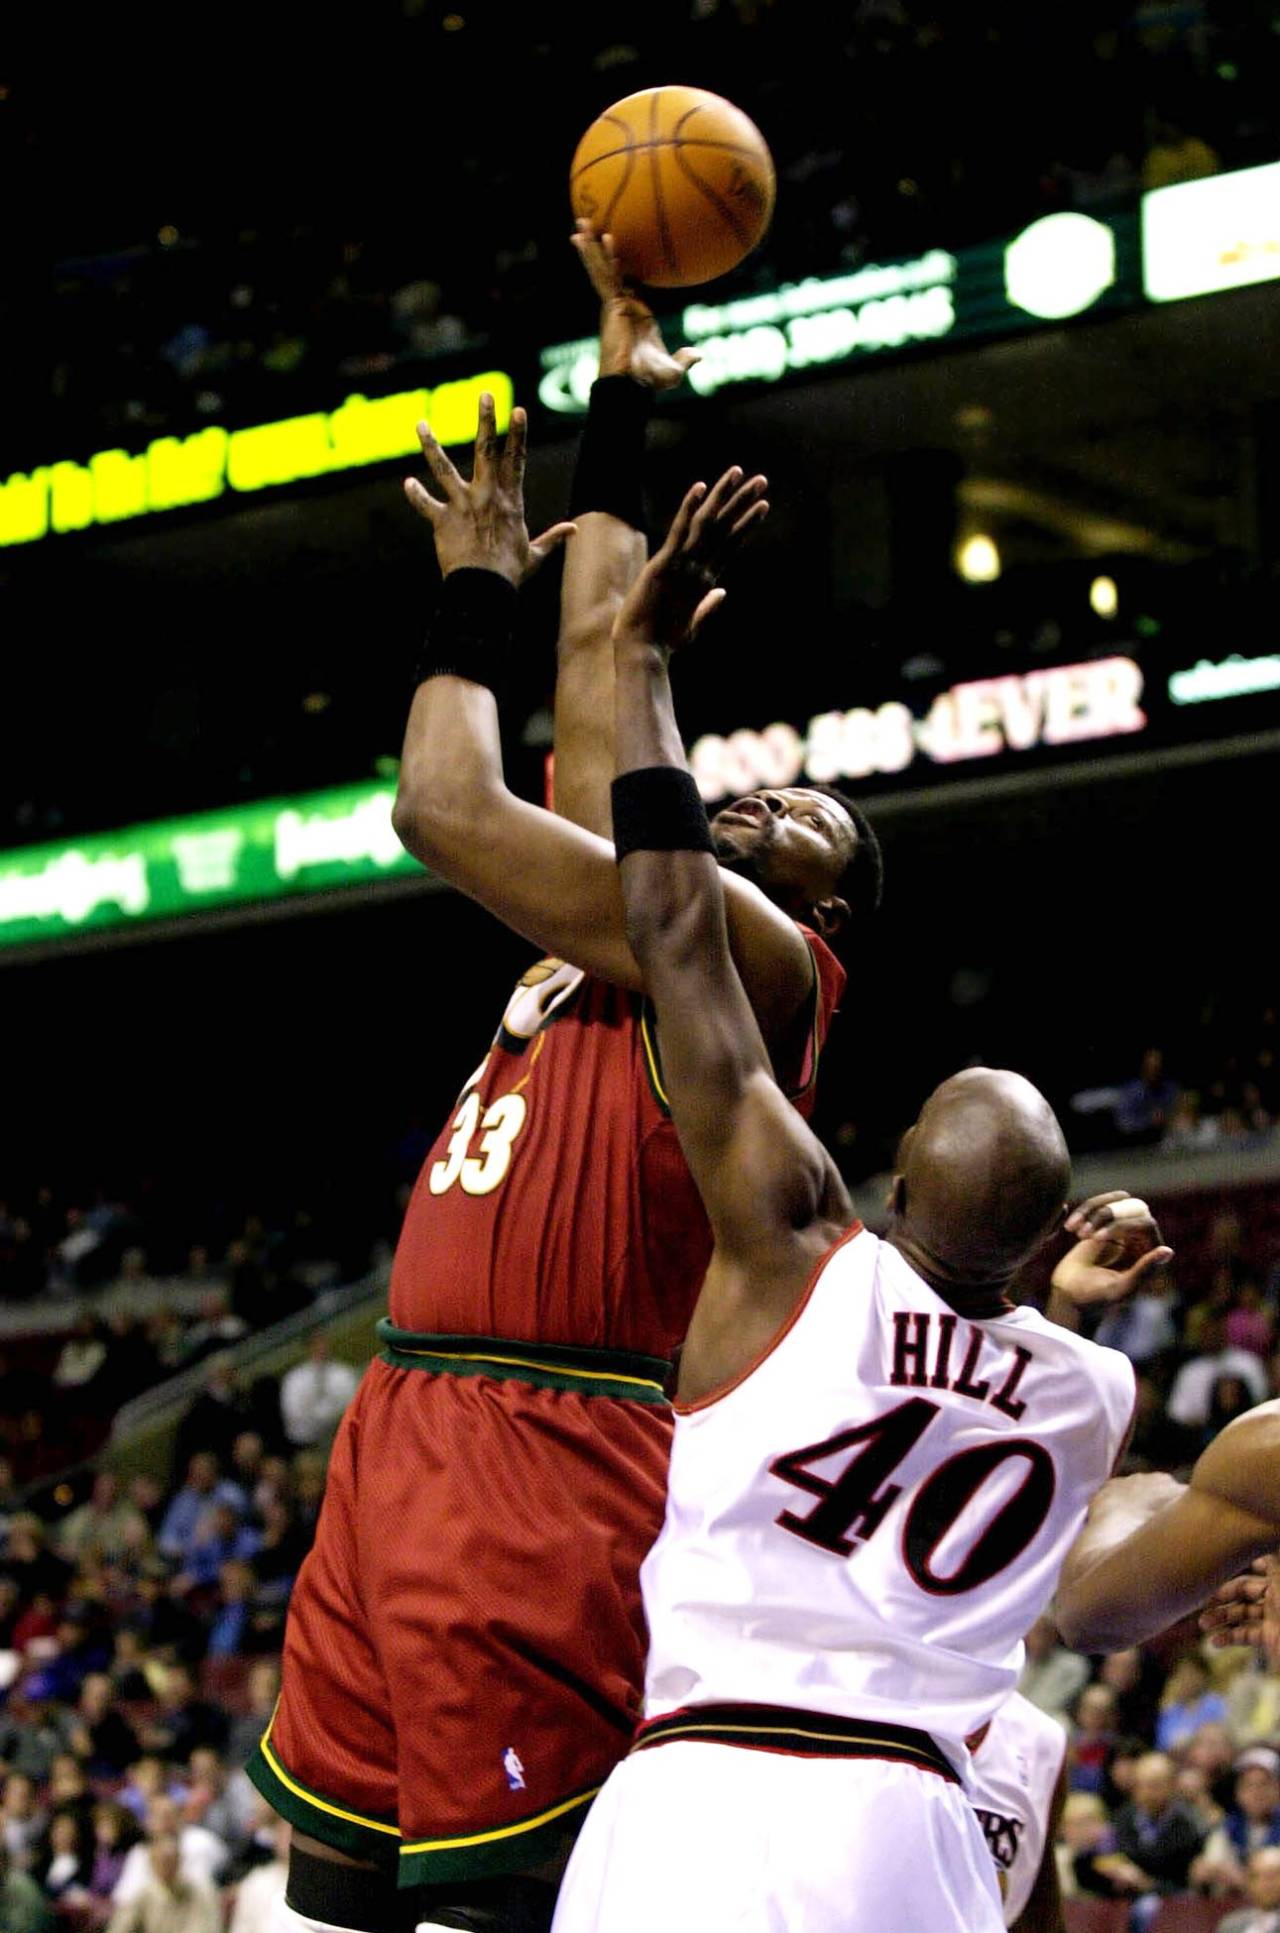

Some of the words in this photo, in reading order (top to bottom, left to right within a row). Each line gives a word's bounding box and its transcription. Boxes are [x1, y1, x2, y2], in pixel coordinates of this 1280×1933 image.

[429, 1092, 526, 1195] 33
[890, 1311, 1033, 1422] HILL
[768, 1397, 1056, 1597] 40
